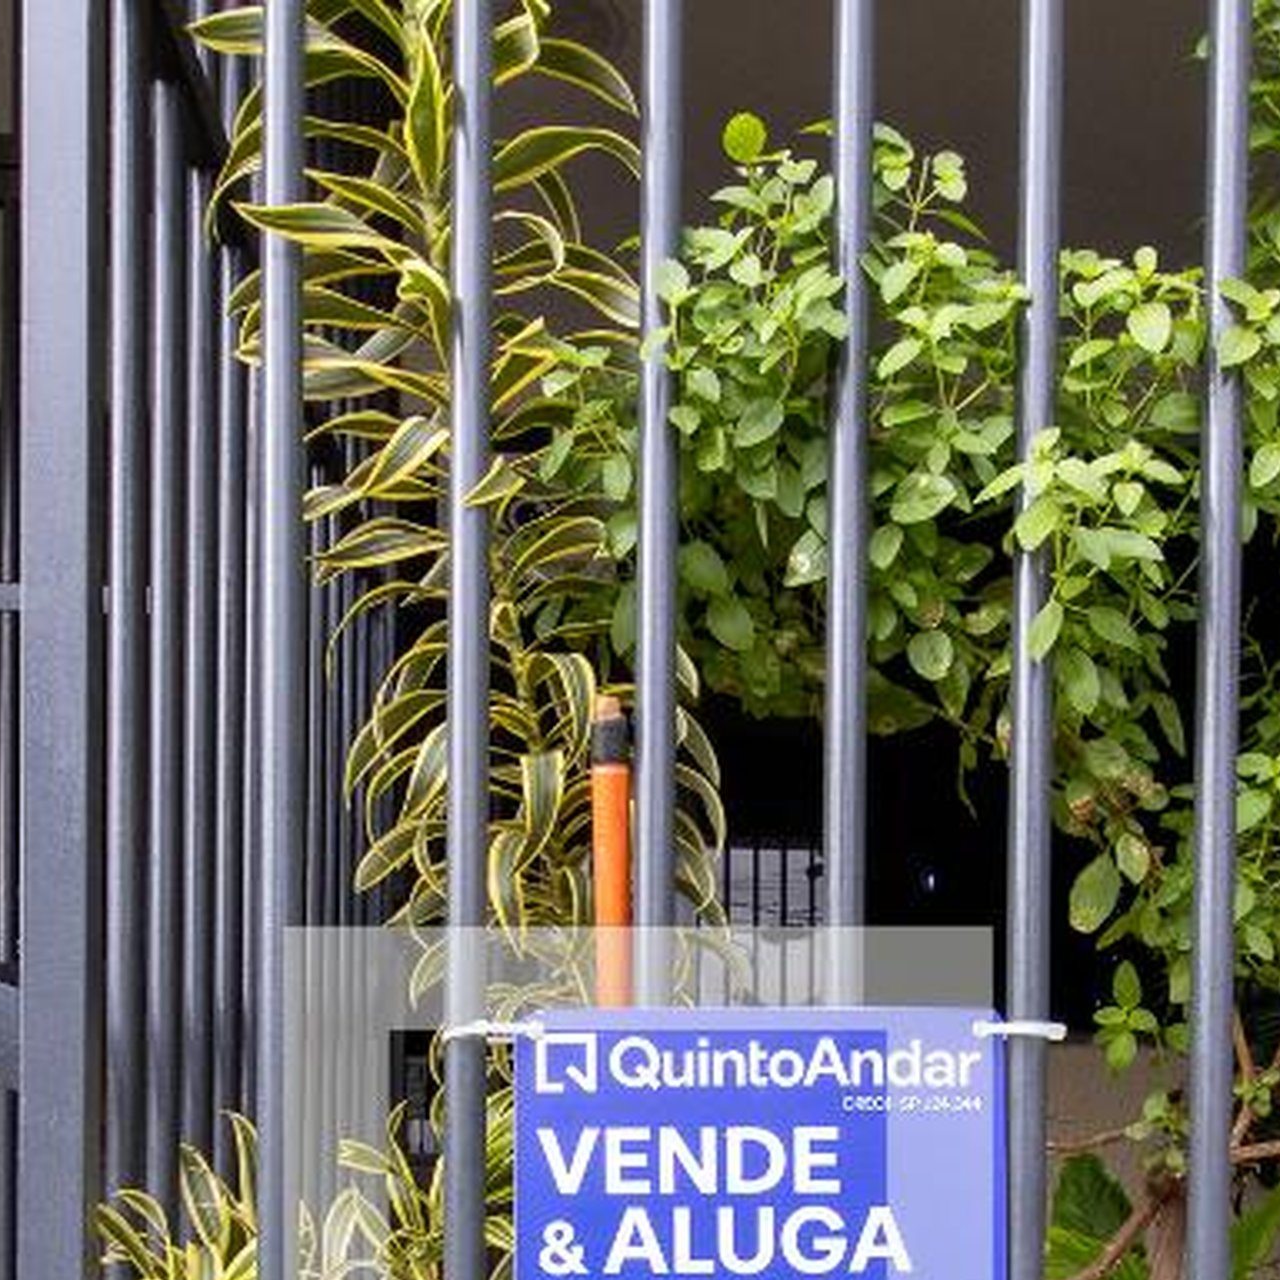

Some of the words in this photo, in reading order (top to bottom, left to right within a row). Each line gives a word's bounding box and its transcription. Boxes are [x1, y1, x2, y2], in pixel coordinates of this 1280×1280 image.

[609, 1036, 981, 1091] QuintoAndar
[535, 1126, 841, 1195] VENDE
[538, 1220, 588, 1276] &
[603, 1206, 913, 1275] ALUGA
